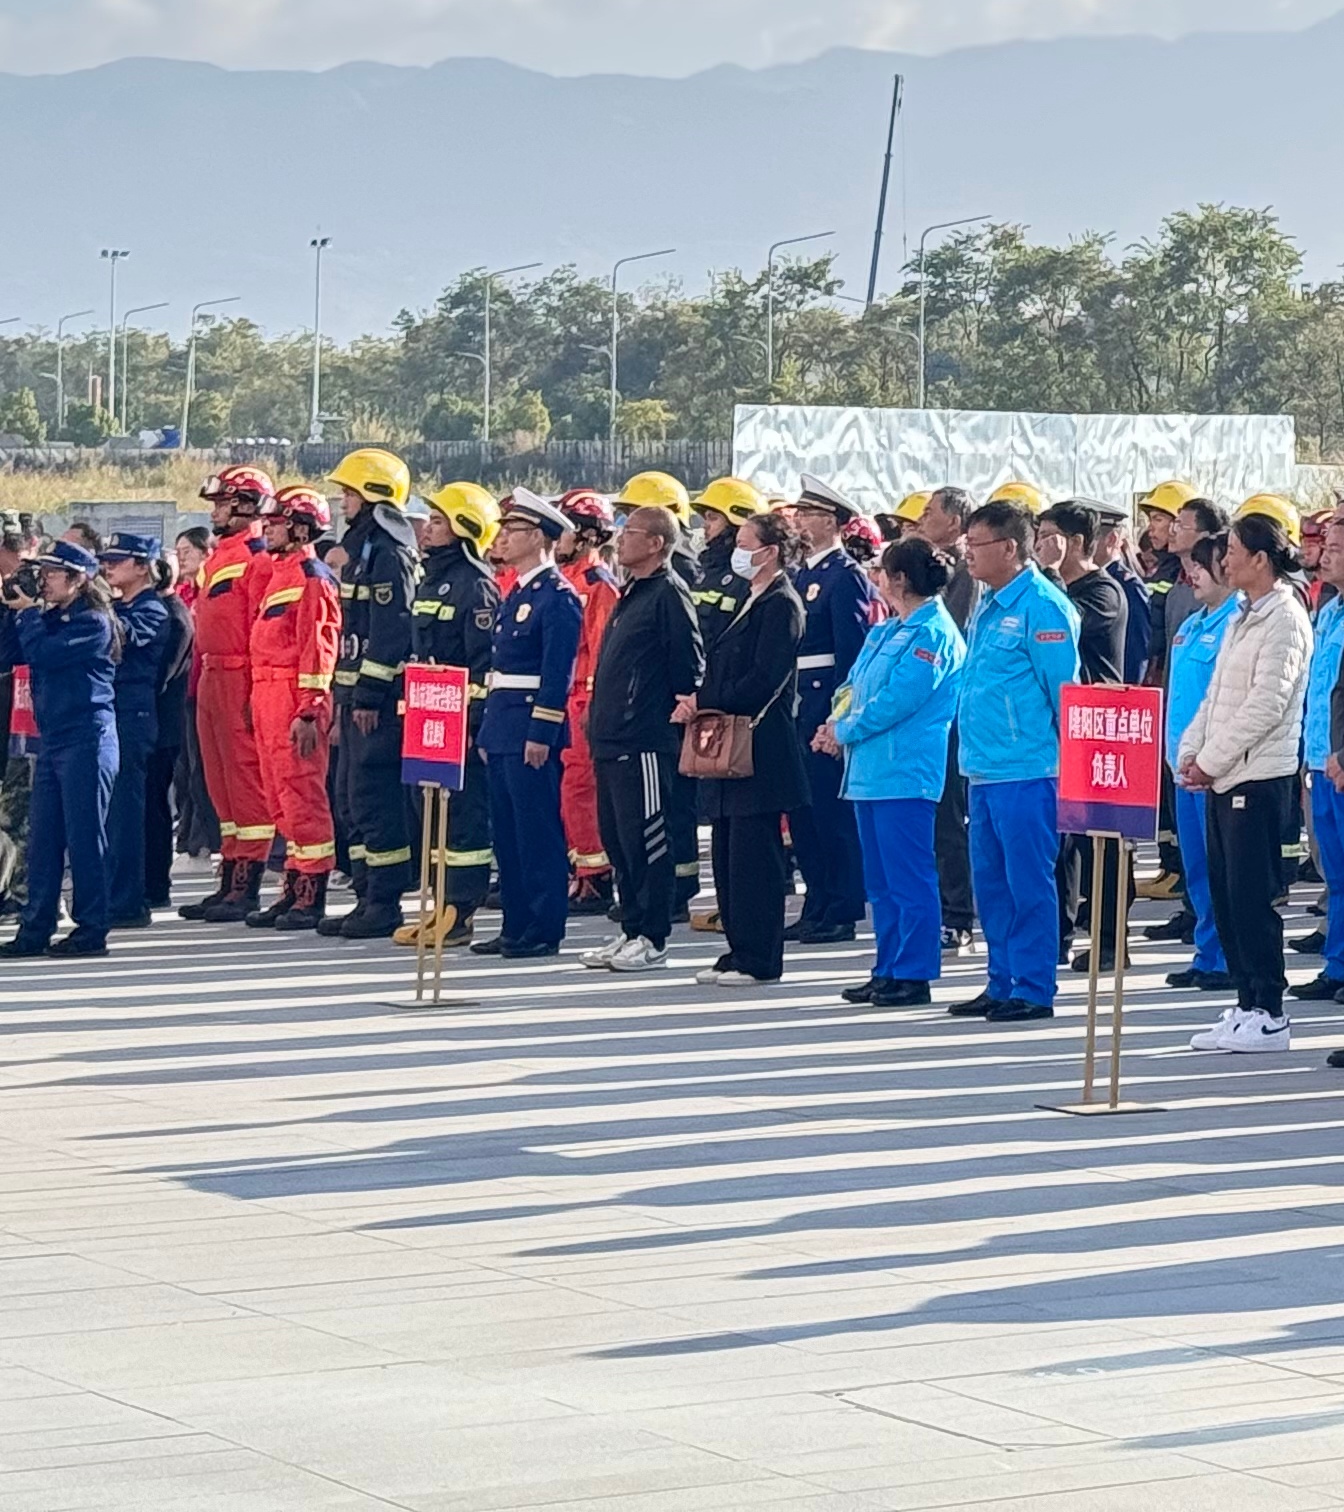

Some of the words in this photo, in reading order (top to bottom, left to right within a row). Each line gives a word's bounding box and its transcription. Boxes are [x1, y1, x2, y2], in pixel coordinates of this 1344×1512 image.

[1068, 706, 1153, 745] 隆阳区重点单位
[1091, 750, 1128, 789] 负责人
